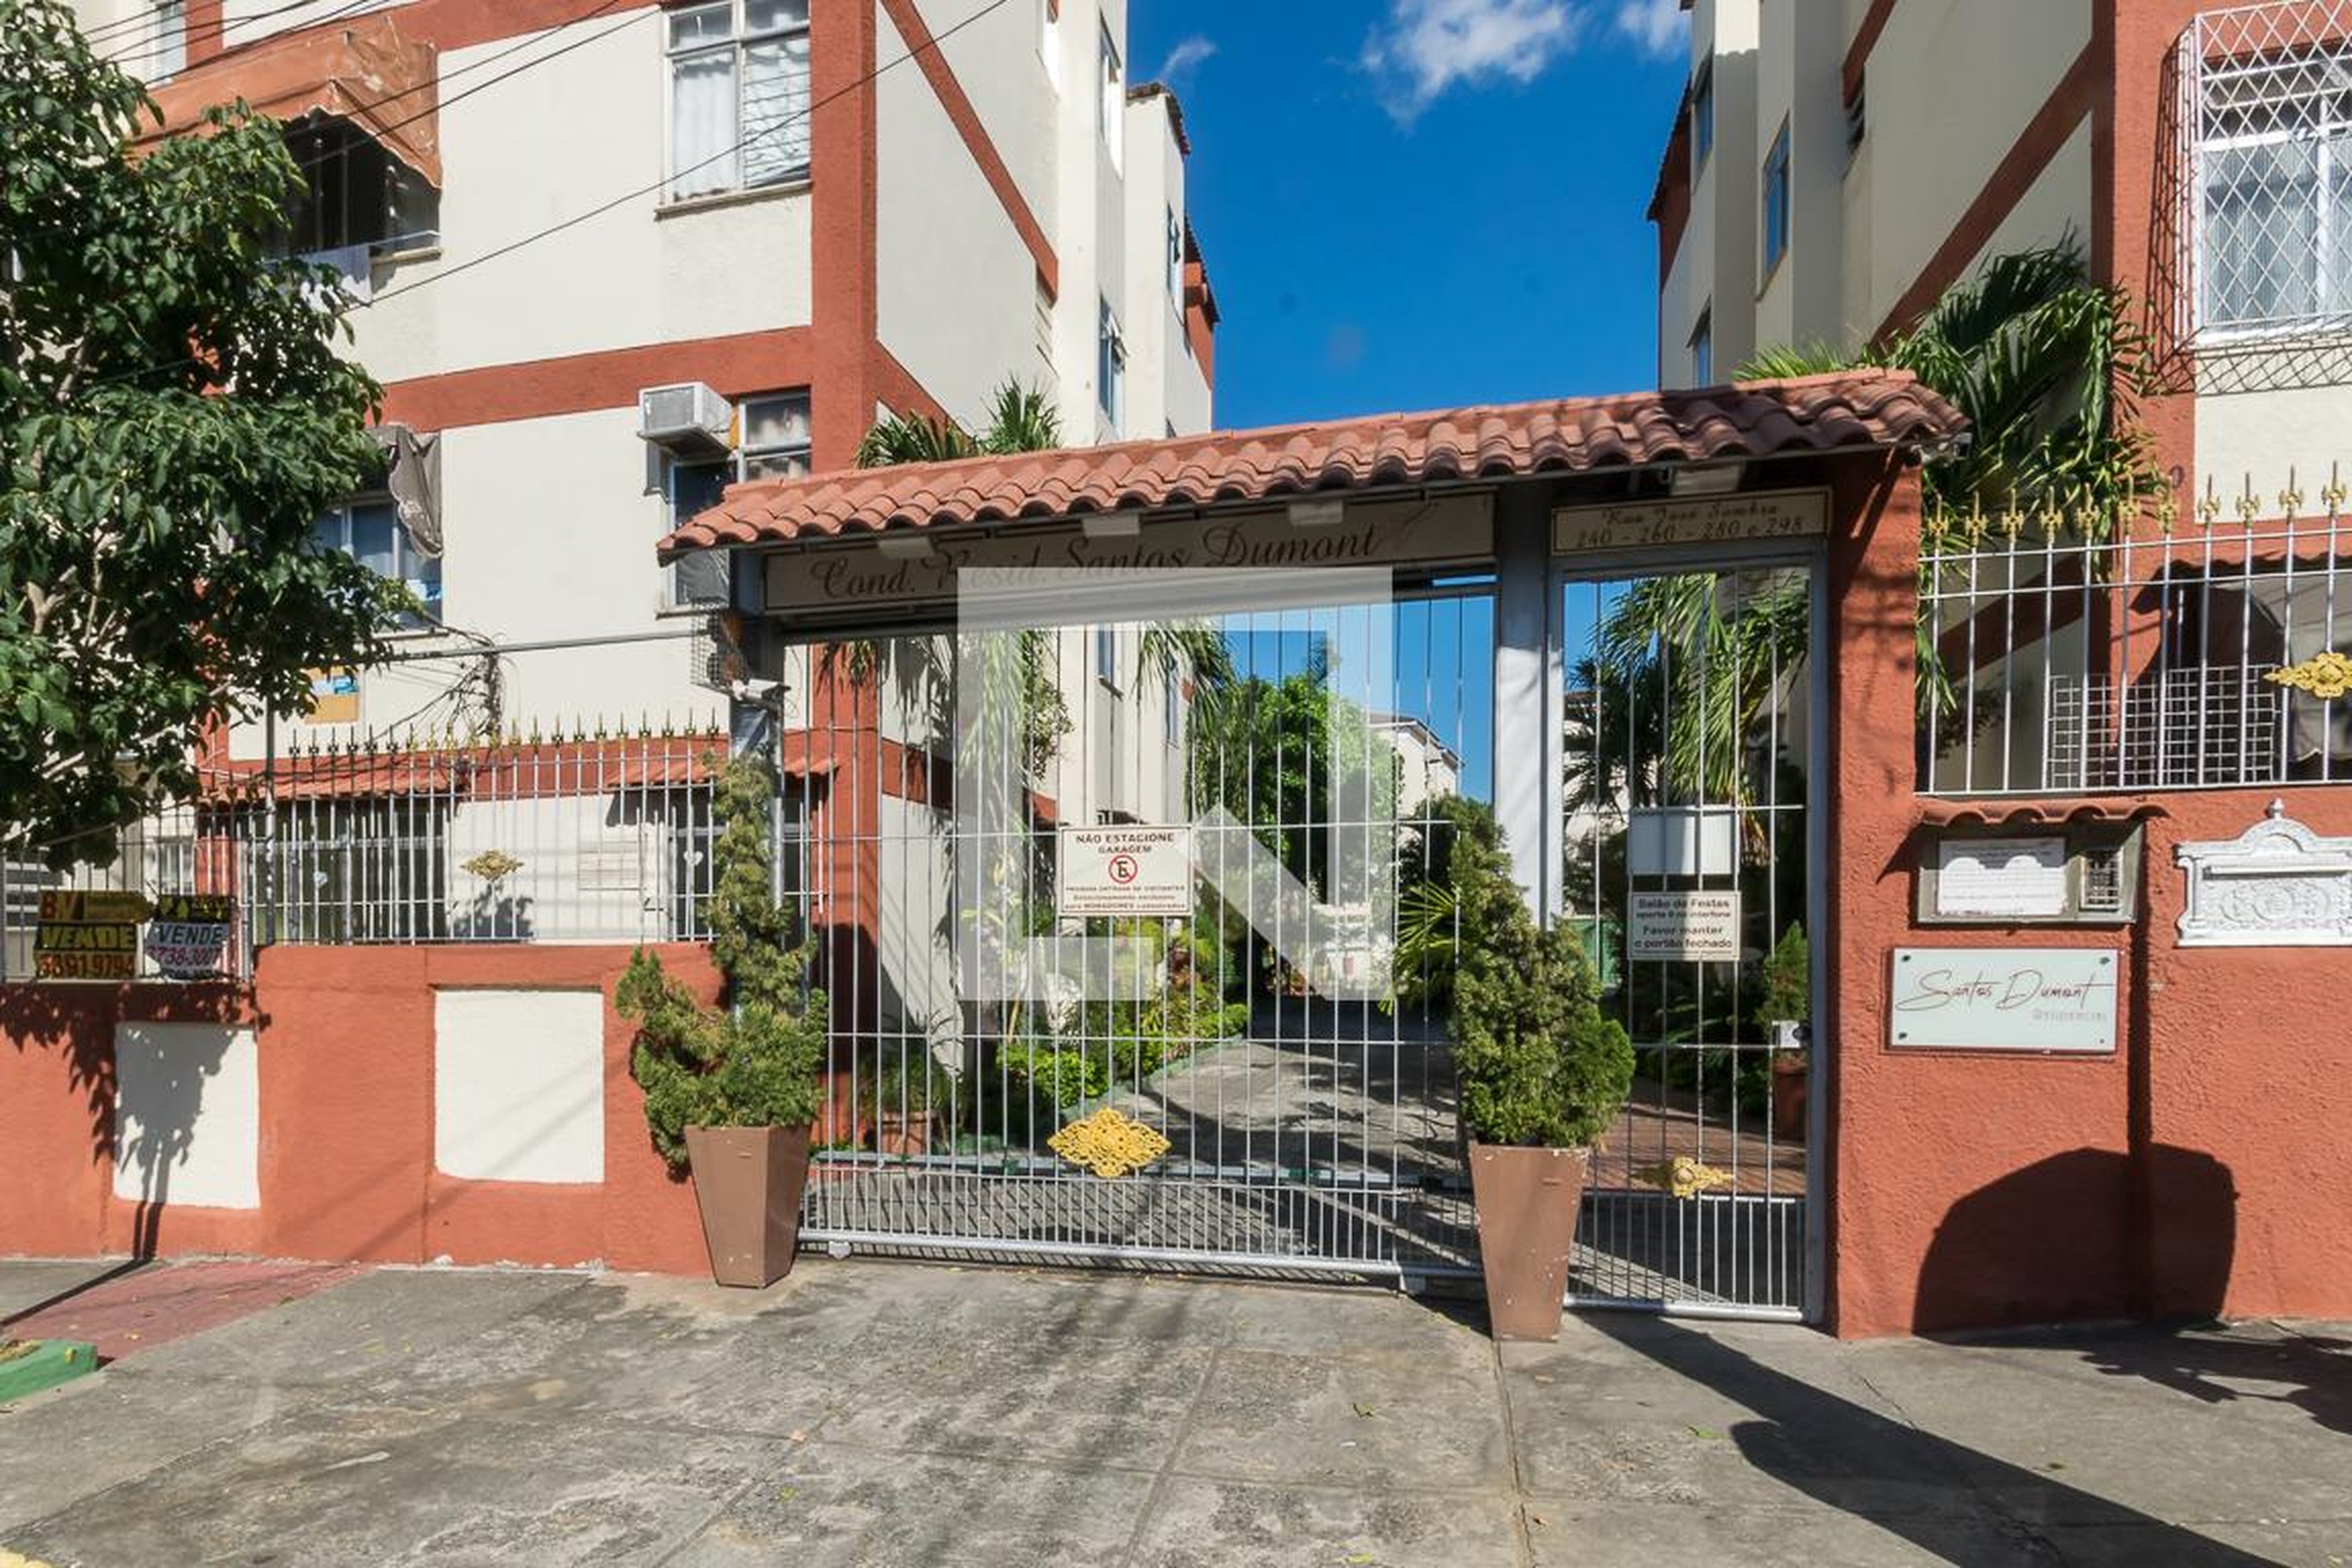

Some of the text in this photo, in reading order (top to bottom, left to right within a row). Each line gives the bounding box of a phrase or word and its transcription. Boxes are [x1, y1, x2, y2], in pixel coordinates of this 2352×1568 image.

[810, 556, 916, 598] Cond.
[1058, 537, 1191, 579] Santos
[1202, 521, 1382, 568] Dumont
[1076, 832, 1175, 843] NÃO ESTACIONE
[1098, 845, 1152, 854] GARAGEM
[1691, 898, 1730, 908] Festas
[158, 925, 224, 945] VENDE
[1679, 925, 1723, 935] manter
[42, 925, 135, 948] VENDE
[1685, 938, 1733, 948] fechado
[1895, 969, 2114, 1011] Santos Dumont
